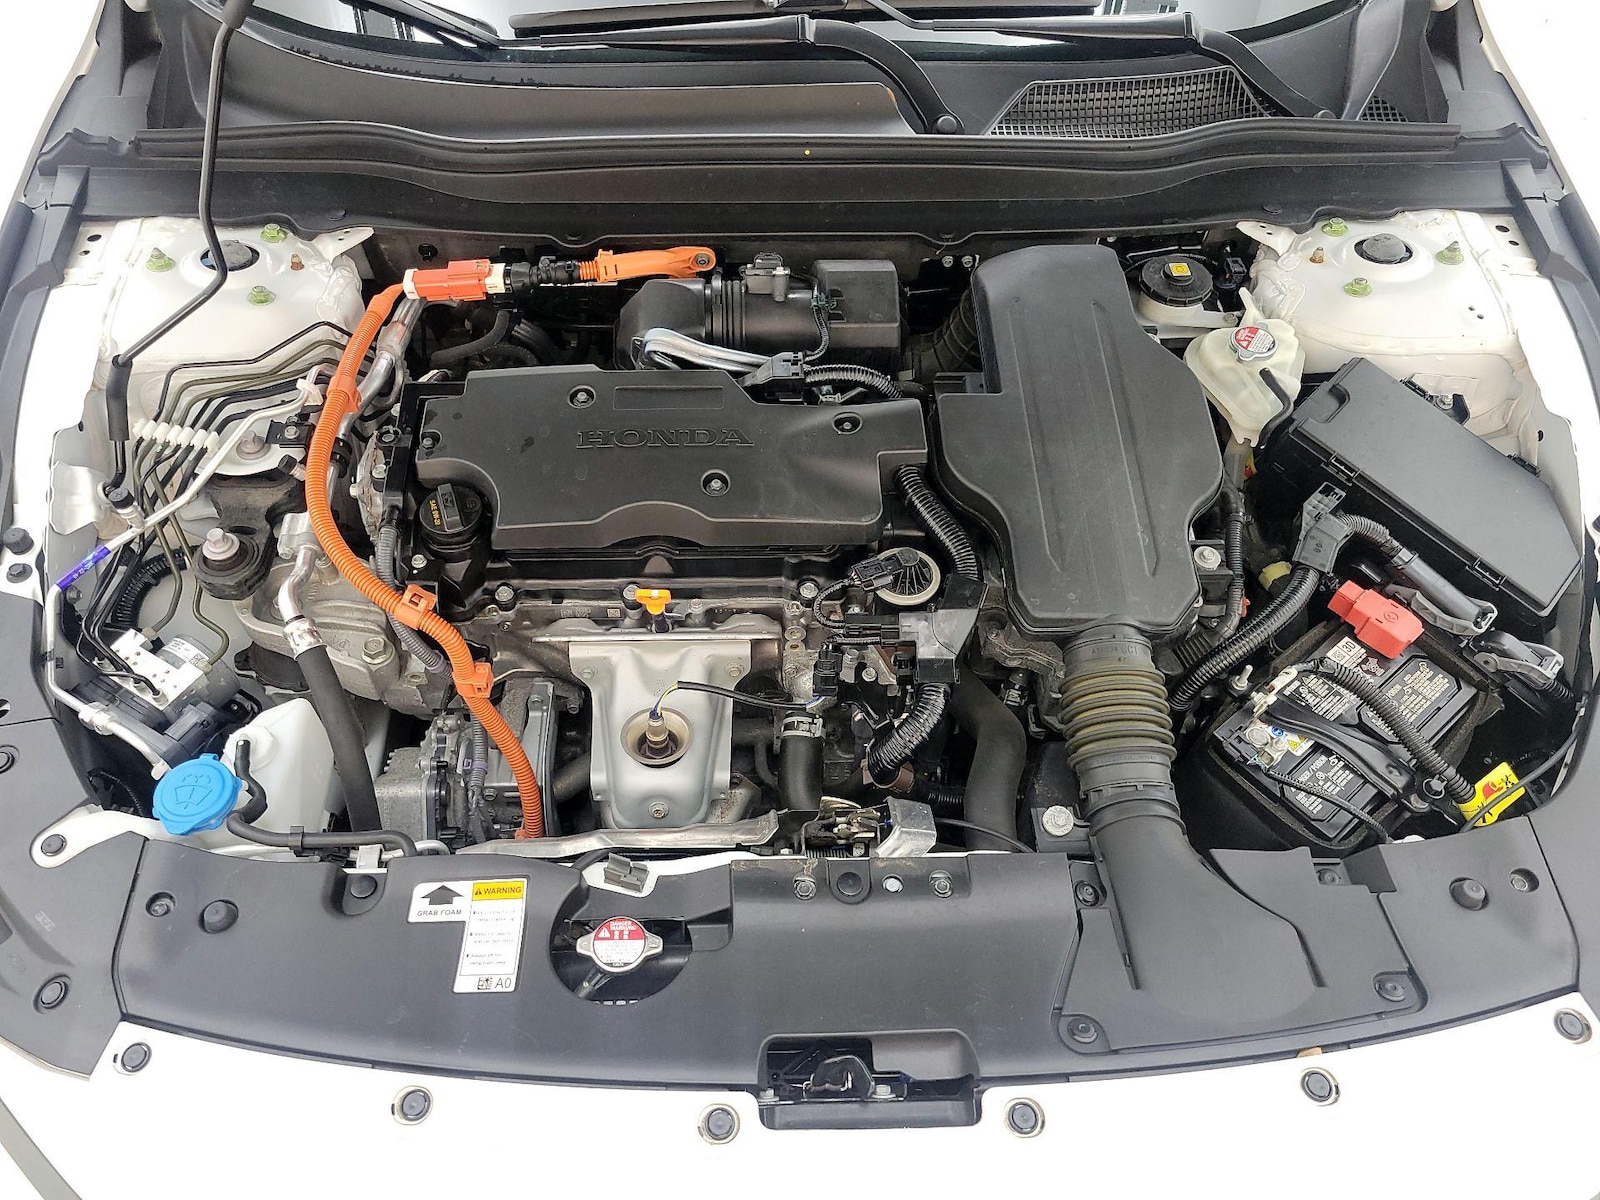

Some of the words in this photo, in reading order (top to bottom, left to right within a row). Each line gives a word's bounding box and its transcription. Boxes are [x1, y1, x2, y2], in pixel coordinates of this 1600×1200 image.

[576, 428, 755, 449] HONDA
[483, 885, 523, 895] WARNING
[494, 977, 513, 989] A0
